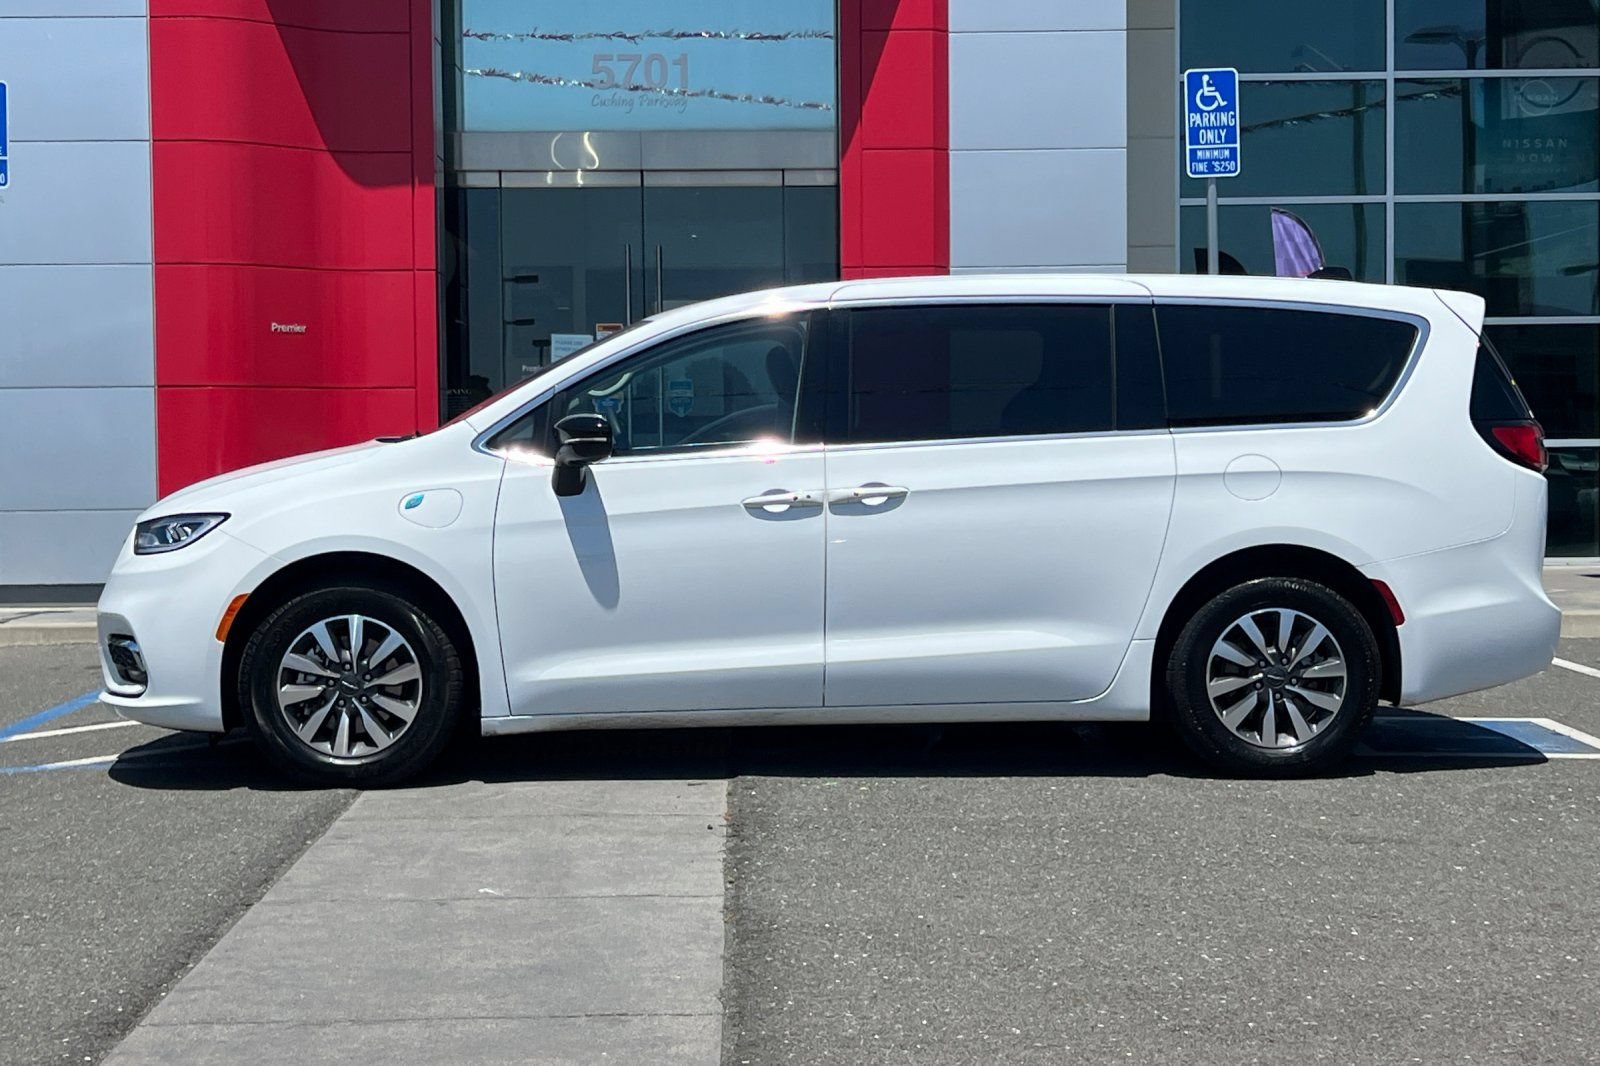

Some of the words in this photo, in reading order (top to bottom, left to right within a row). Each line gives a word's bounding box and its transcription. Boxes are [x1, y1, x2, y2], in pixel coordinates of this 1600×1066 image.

[591, 53, 688, 90] 5701
[591, 91, 634, 114] Cushing
[638, 92, 688, 114] Parkway
[1189, 111, 1235, 127] PARKING
[1199, 129, 1227, 144] ONLY
[1502, 138, 1568, 149] NISSAN
[1197, 149, 1230, 160] MINIMUM
[1515, 153, 1554, 163] NOW
[1191, 162, 1208, 172] FINE
[271, 322, 307, 333] Premier
